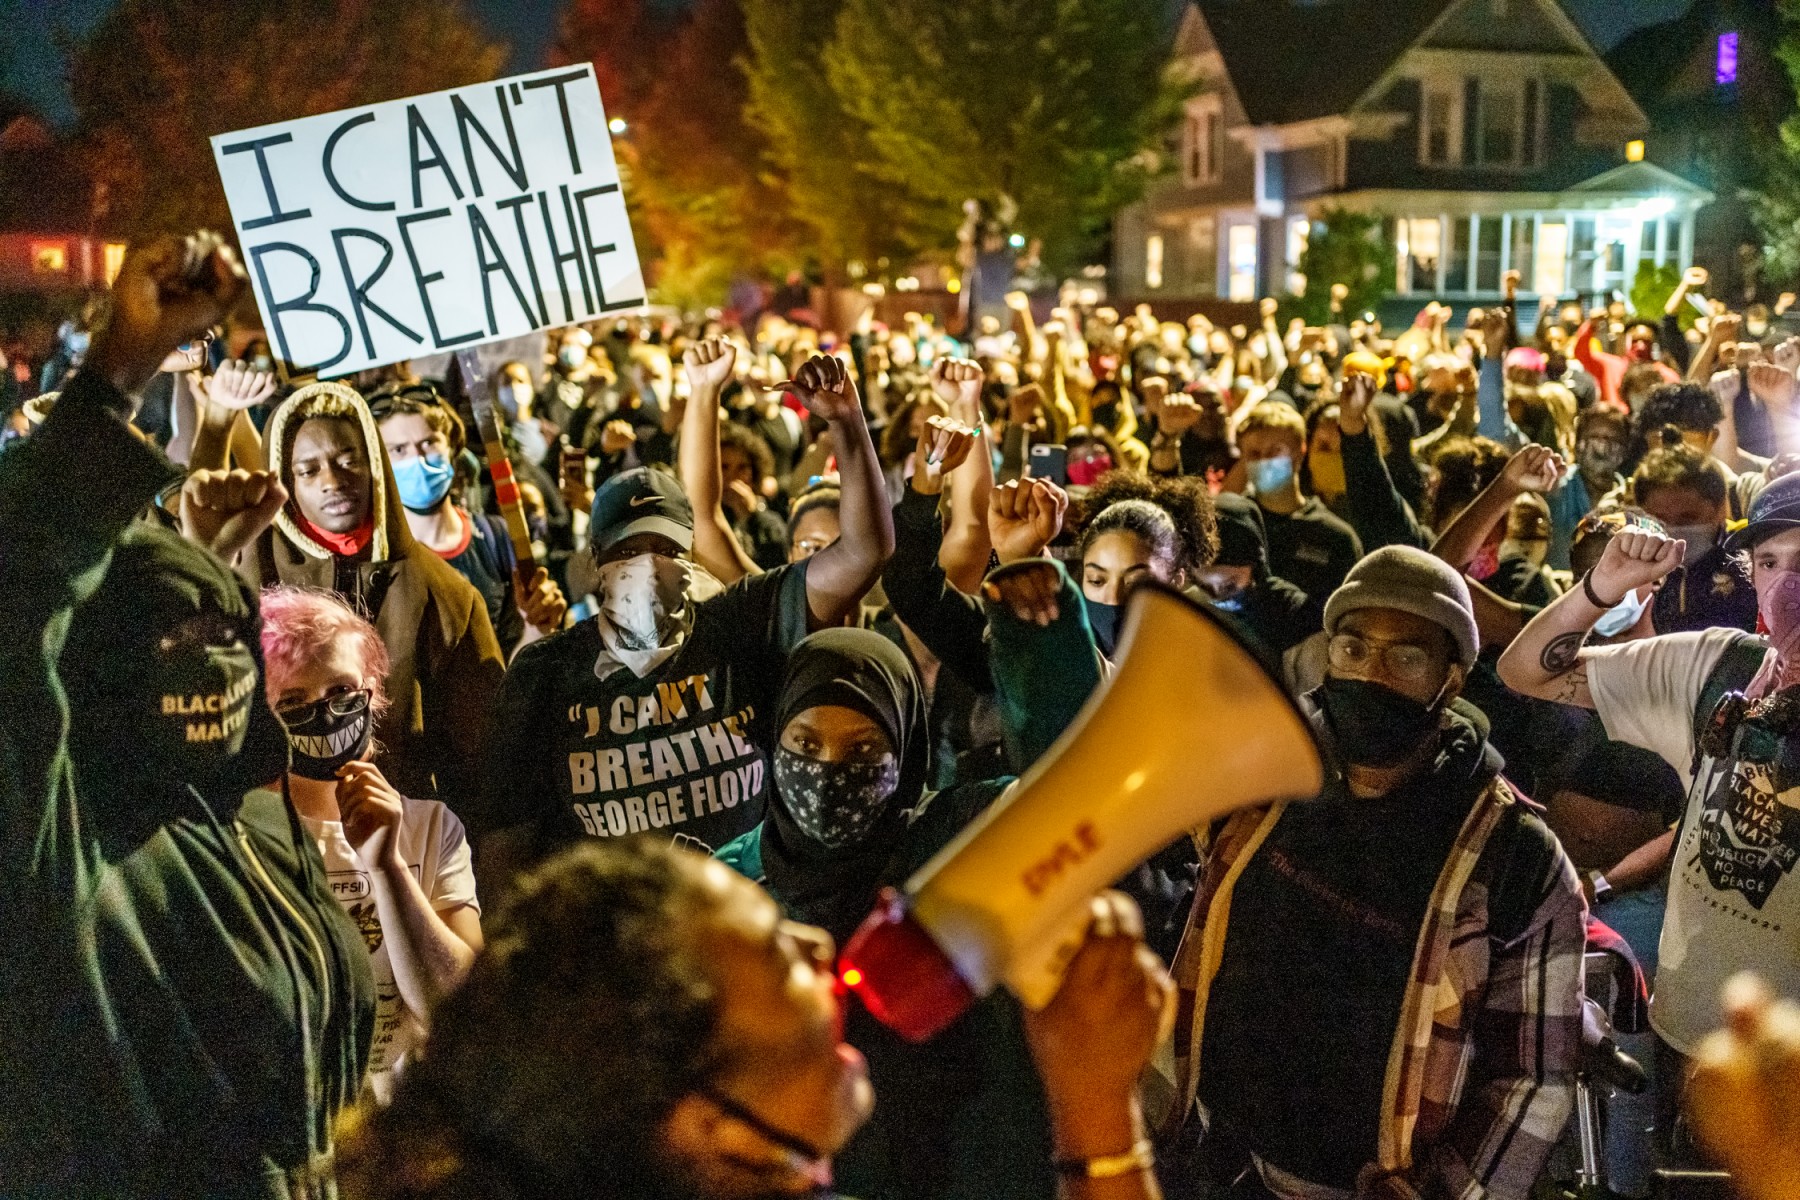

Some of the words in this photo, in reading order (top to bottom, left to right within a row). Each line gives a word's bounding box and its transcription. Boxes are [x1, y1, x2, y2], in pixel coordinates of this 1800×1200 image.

[222, 132, 312, 231] I
[321, 69, 590, 212] CAN'T
[249, 184, 646, 379] BREATHE
[609, 673, 715, 735] CAN'T
[573, 785, 688, 838] GEORGE
[690, 759, 764, 818] FLOYD
[1730, 774, 1776, 813] BLACK
[1735, 801, 1783, 835] LIVES
[1734, 819, 1796, 863] MATTER
[1713, 860, 1734, 874] NO
[1720, 874, 1766, 893] PEACE
